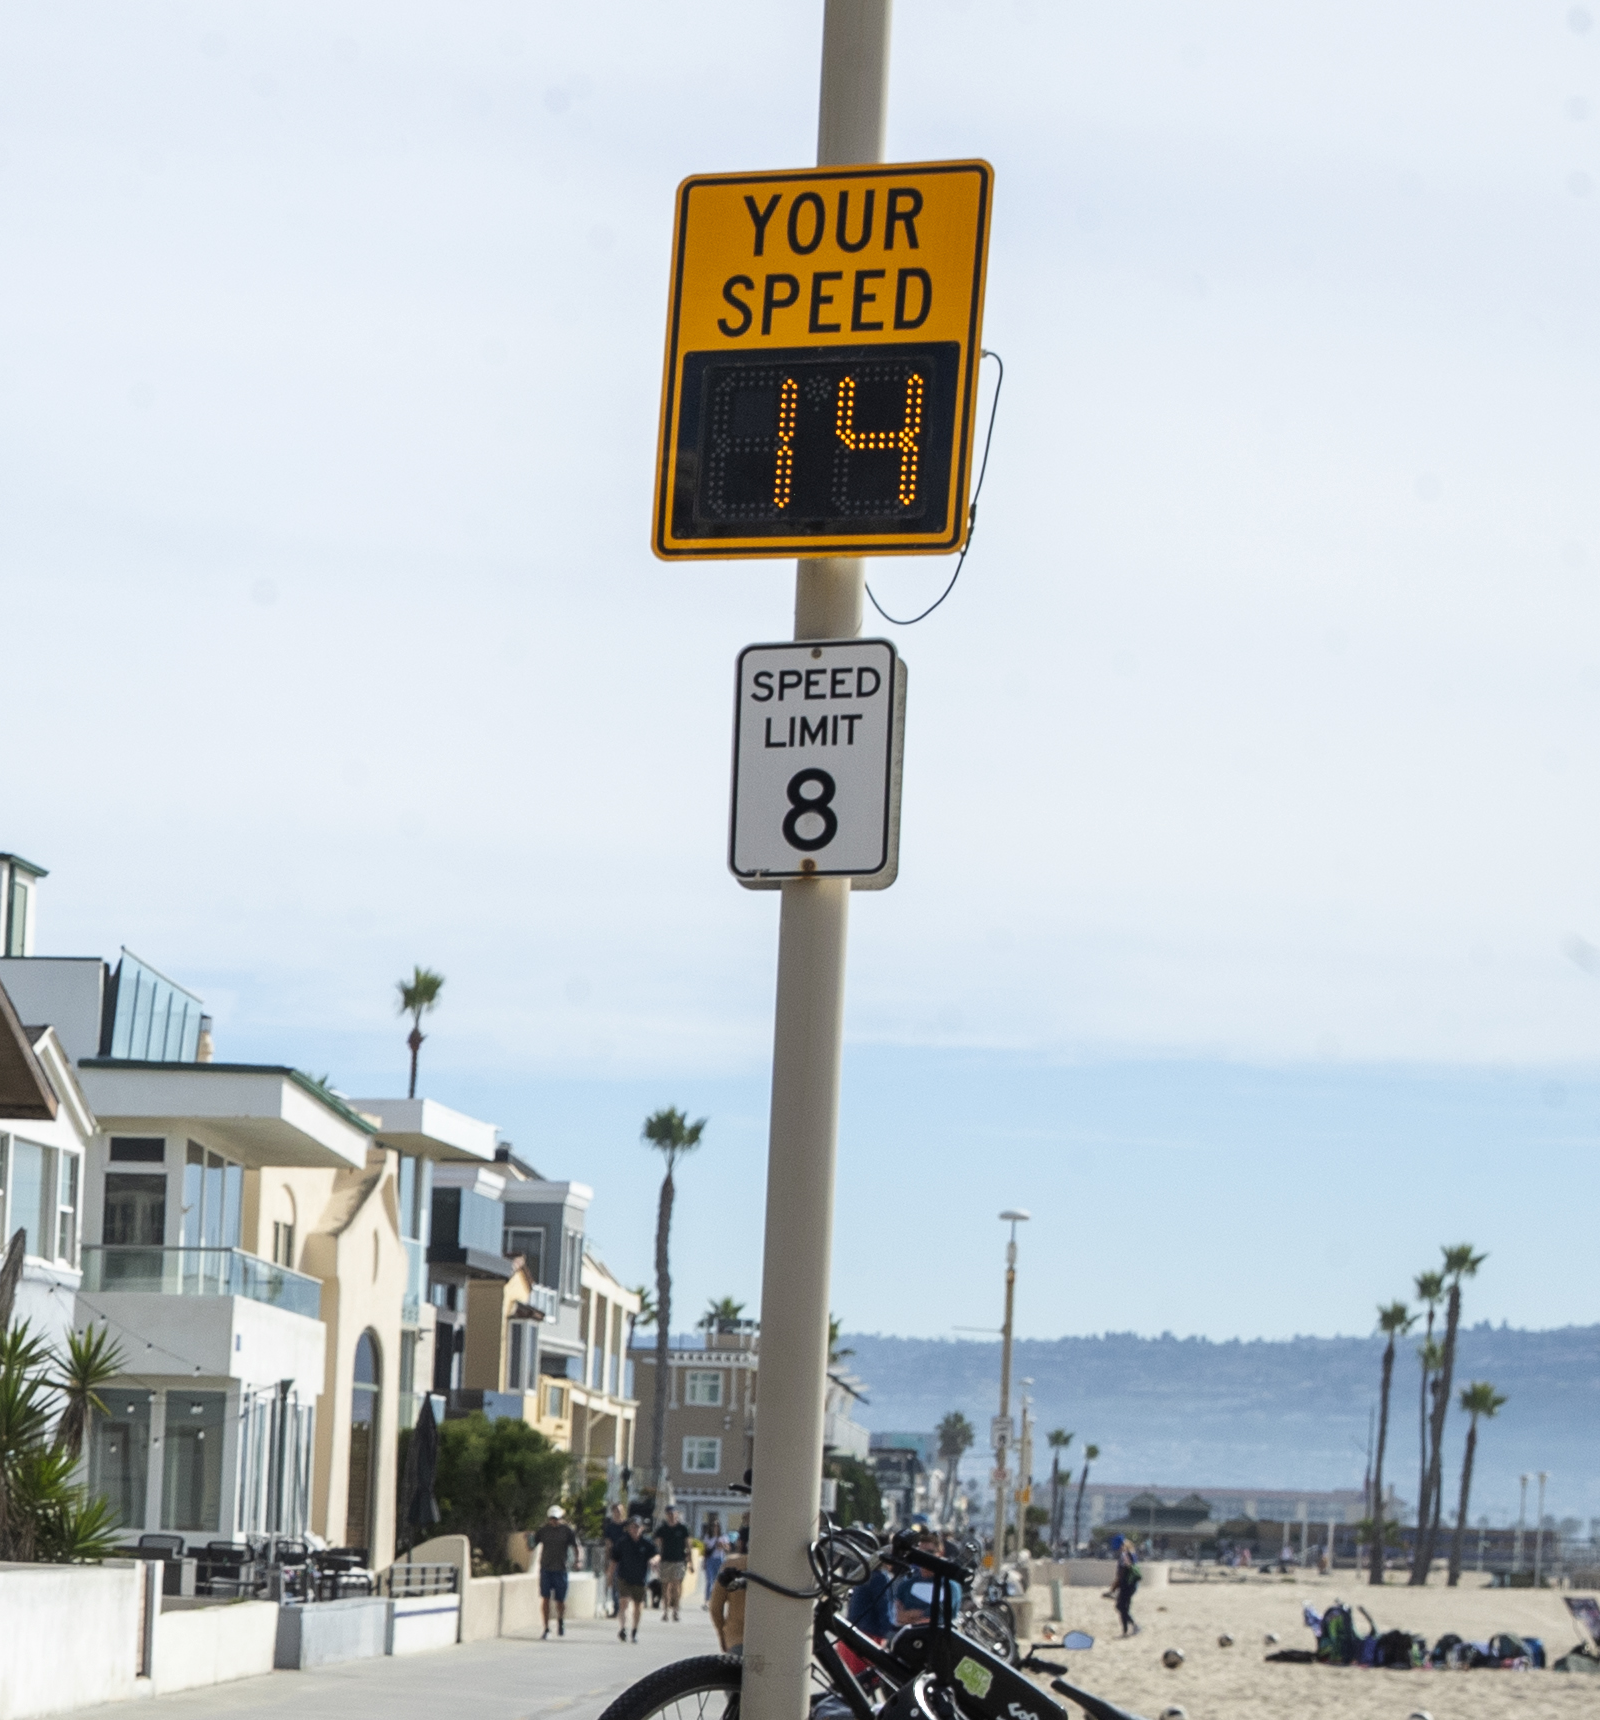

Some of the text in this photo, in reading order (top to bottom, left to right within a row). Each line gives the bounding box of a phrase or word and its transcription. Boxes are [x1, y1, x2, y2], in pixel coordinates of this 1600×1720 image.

[743, 186, 925, 257] YOUR
[717, 267, 933, 338] SPEED
[773, 373, 924, 510] 14
[750, 666, 881, 702] SPEED
[764, 714, 863, 749] LIMIT
[781, 767, 838, 852] 8
